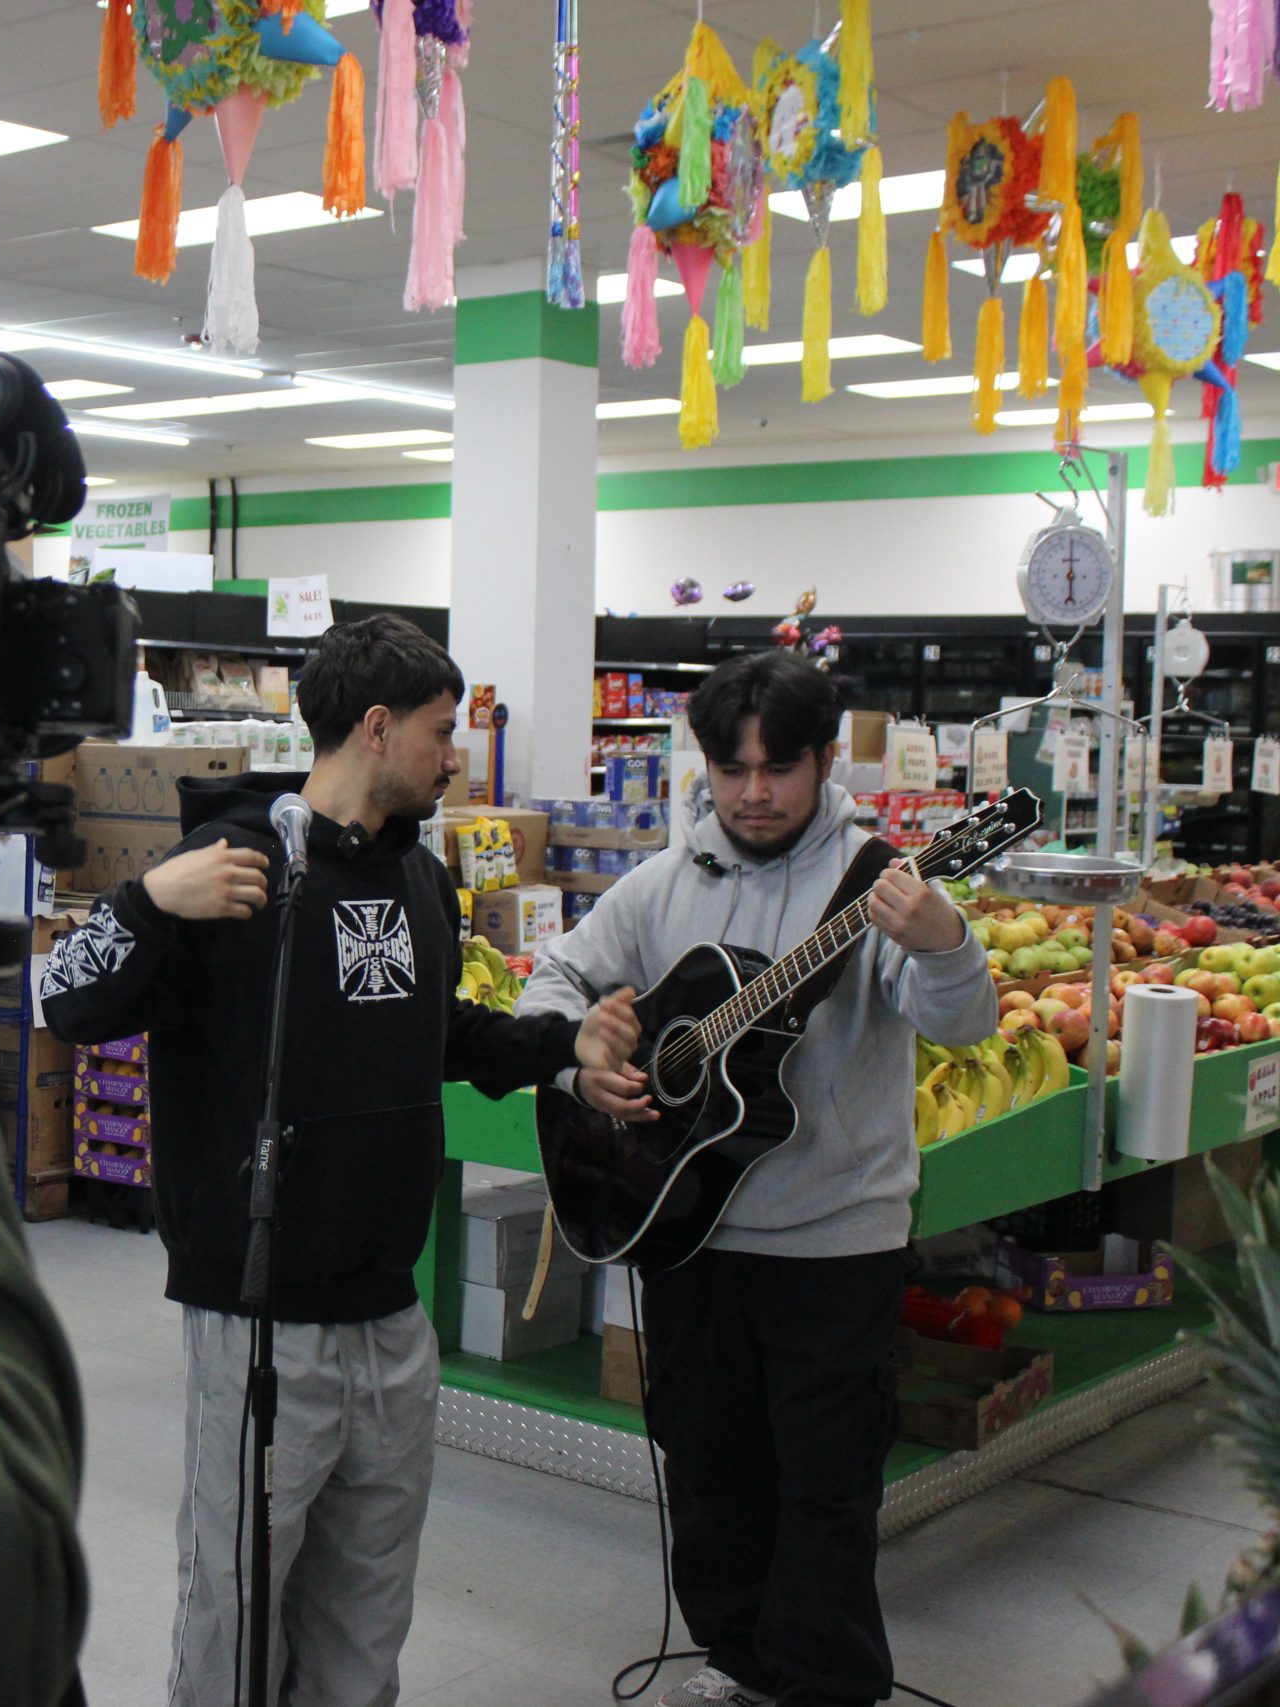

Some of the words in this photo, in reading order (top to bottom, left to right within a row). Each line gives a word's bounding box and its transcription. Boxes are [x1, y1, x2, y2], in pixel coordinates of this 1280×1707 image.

[96, 502, 152, 518] FROZEN
[75, 520, 165, 539] VEGETABLES
[359, 906, 379, 940] WEST
[340, 927, 410, 972] CHOPPERS
[367, 957, 386, 993] COAST
[99, 1080, 132, 1091] CHAMPAGNE
[1252, 1086, 1276, 1107] APPLE
[98, 1119, 131, 1130] CHAMPAGNE
[100, 1160, 132, 1171] CHAMPAGNE
